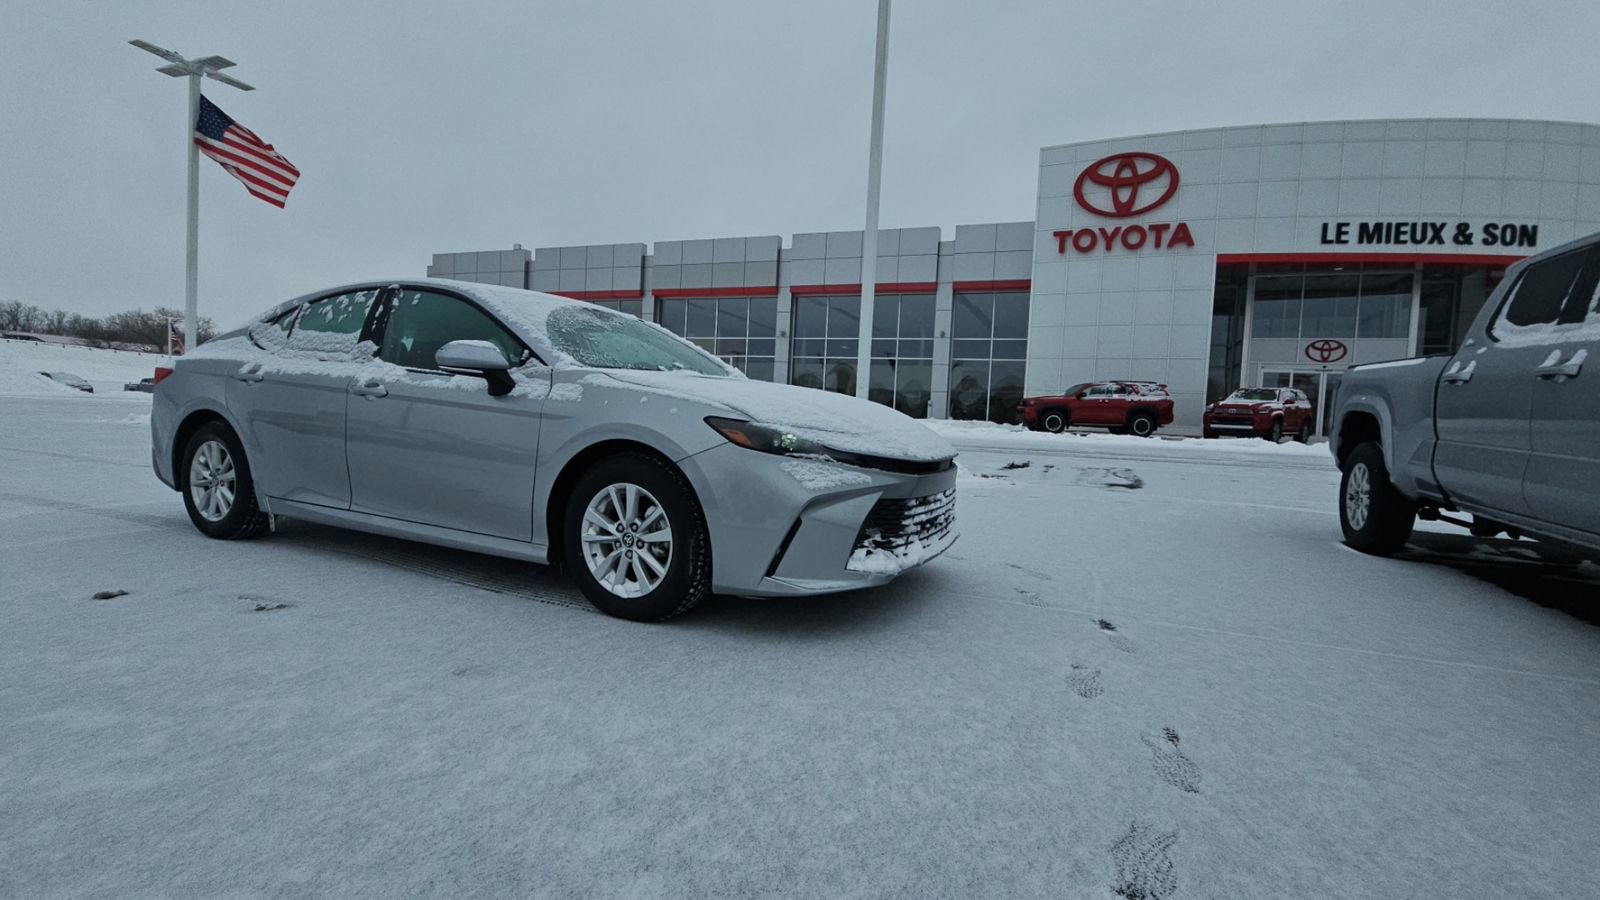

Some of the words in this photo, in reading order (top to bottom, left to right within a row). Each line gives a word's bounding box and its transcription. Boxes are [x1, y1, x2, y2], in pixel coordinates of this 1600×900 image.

[1053, 222, 1195, 254] TOYOTA
[1320, 222, 1350, 245] LE
[1357, 222, 1447, 245] MIEUX
[1452, 222, 1474, 246] &
[1481, 223, 1538, 247] SON
